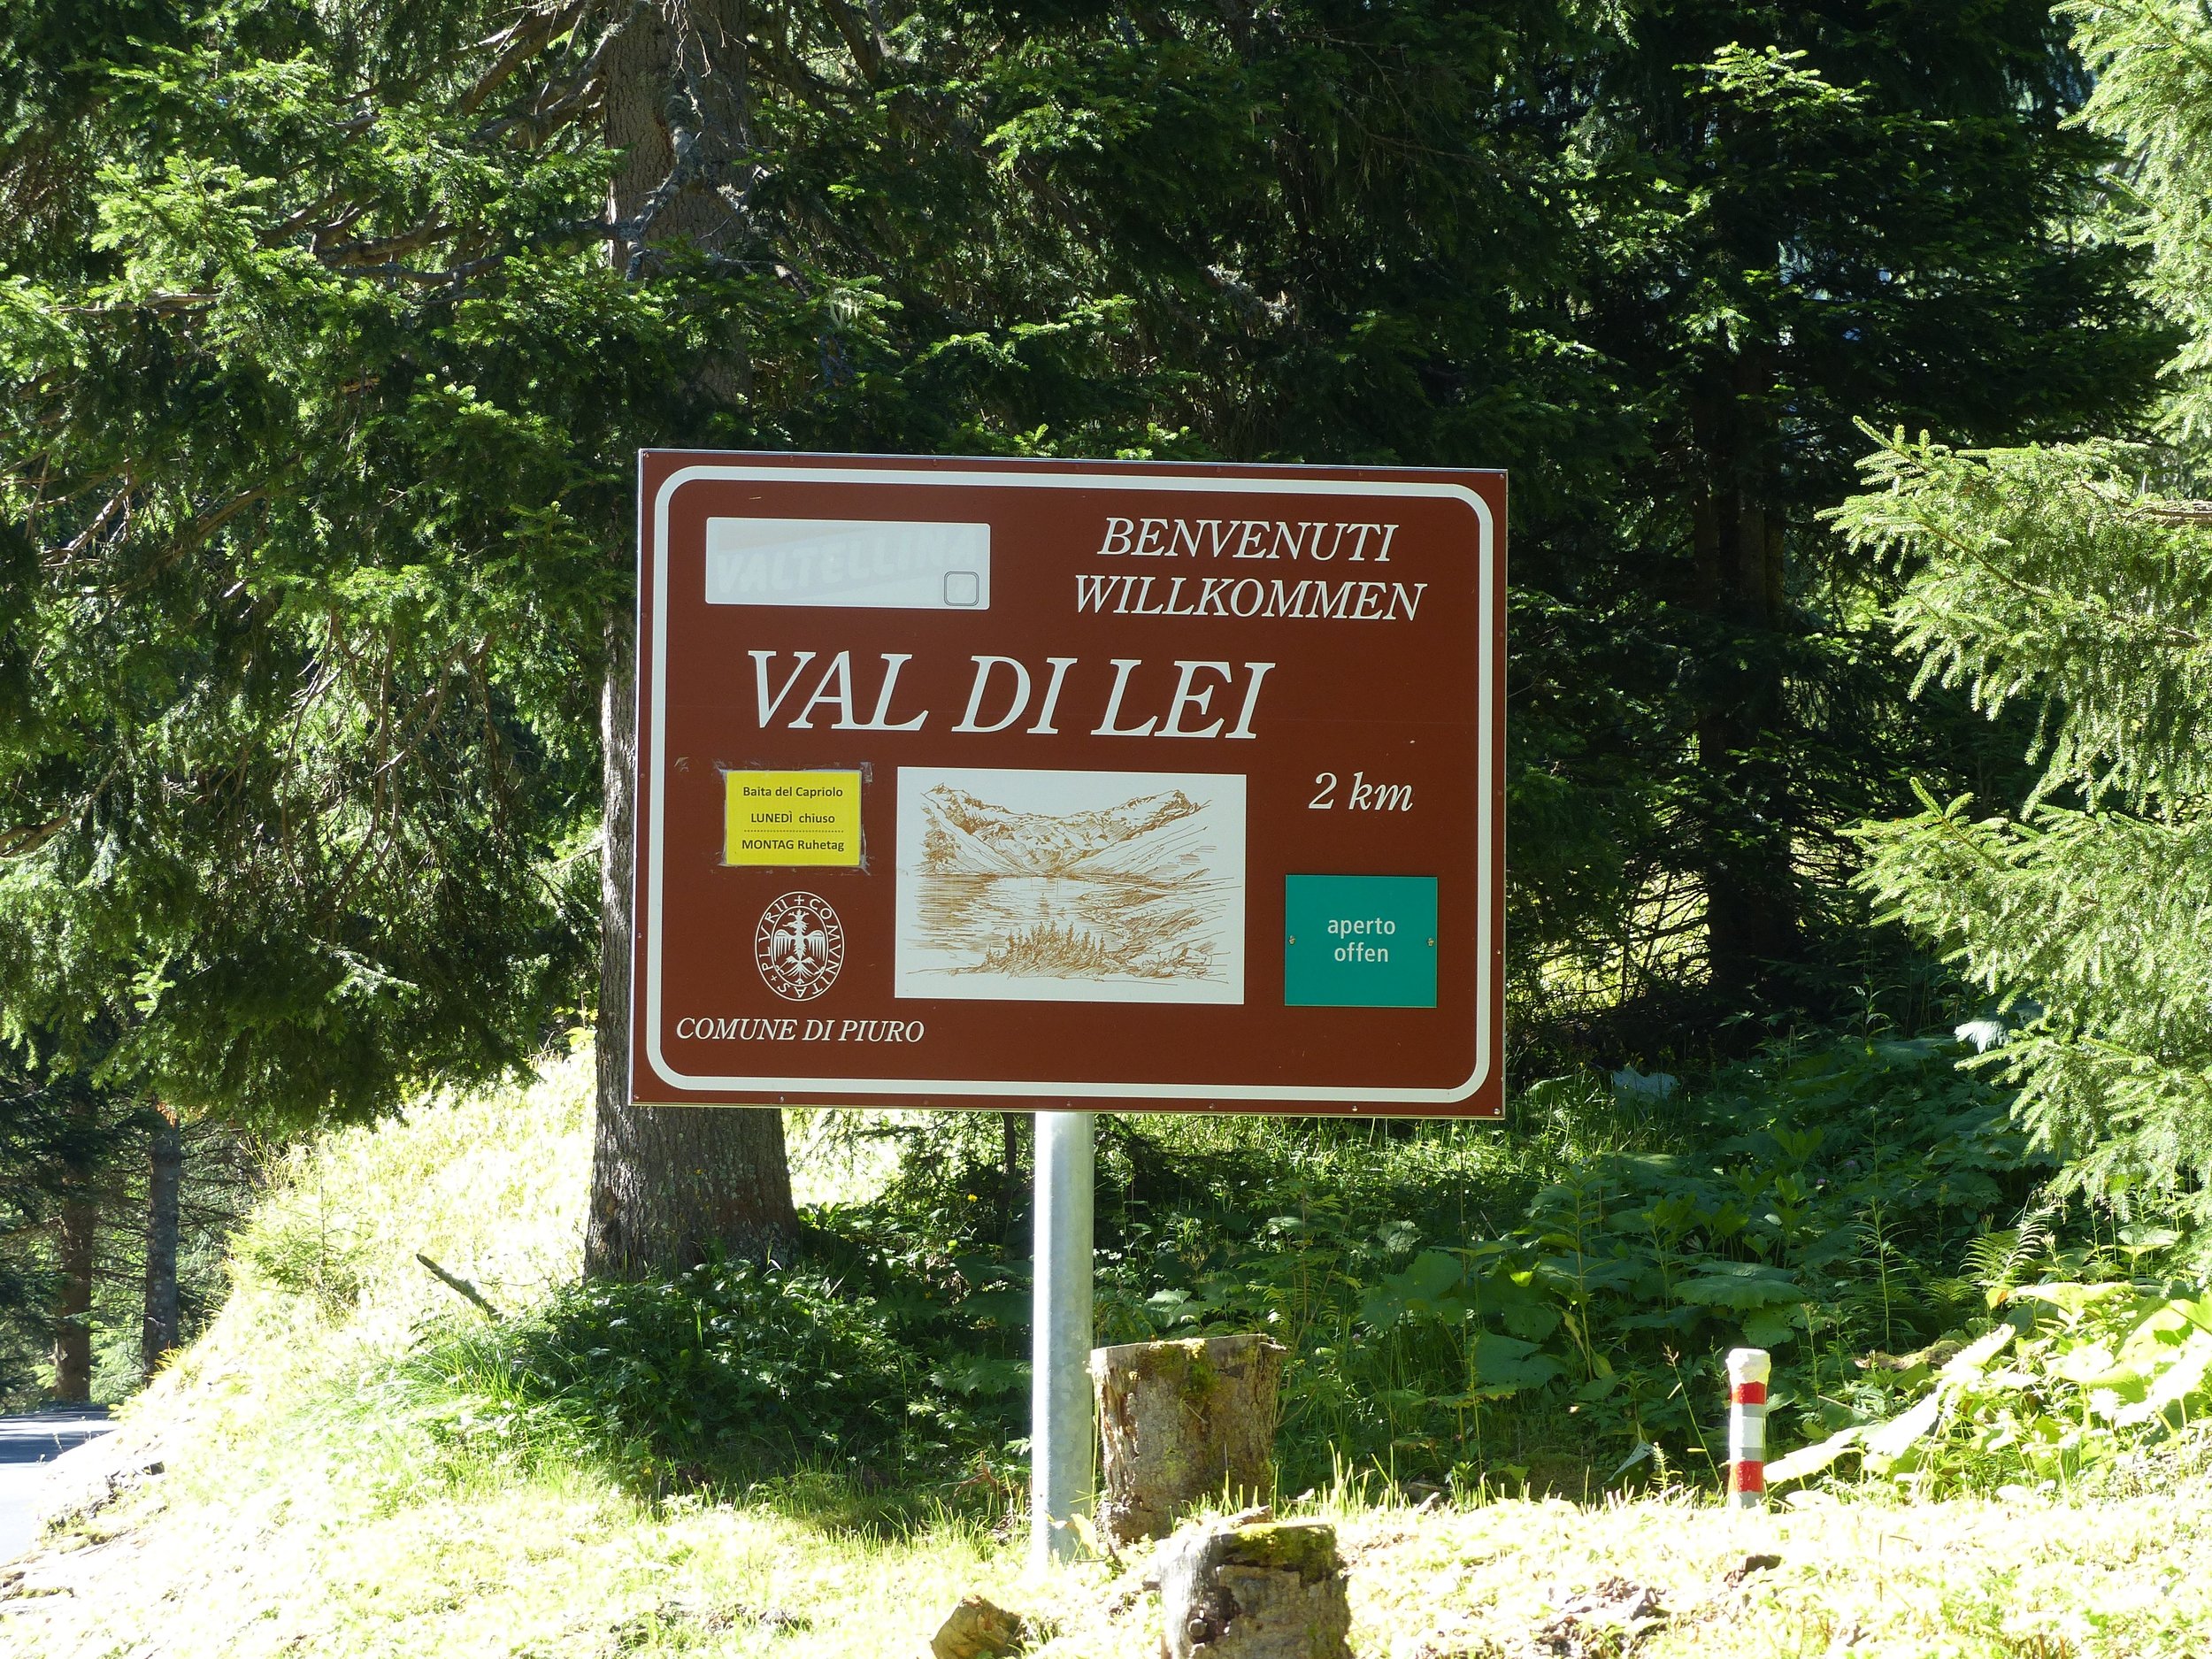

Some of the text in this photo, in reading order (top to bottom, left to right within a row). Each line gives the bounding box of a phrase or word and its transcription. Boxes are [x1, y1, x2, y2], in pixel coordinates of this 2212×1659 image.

[1097, 517, 1399, 562] BENVENUTI
[1075, 574, 1427, 620] WILLKOMMEN
[748, 649, 1276, 739] VAL DI LEI
[742, 786, 843, 799] Baita del Capriolo
[1308, 771, 1413, 811] 2 km
[750, 810, 835, 824] LUNEDÌ chiuso
[741, 839, 845, 852] MONTAG Ruhetag
[1327, 918, 1396, 939] aperto
[1333, 941, 1389, 963] offen
[676, 1017, 925, 1043] COMUNE DI PIURO
